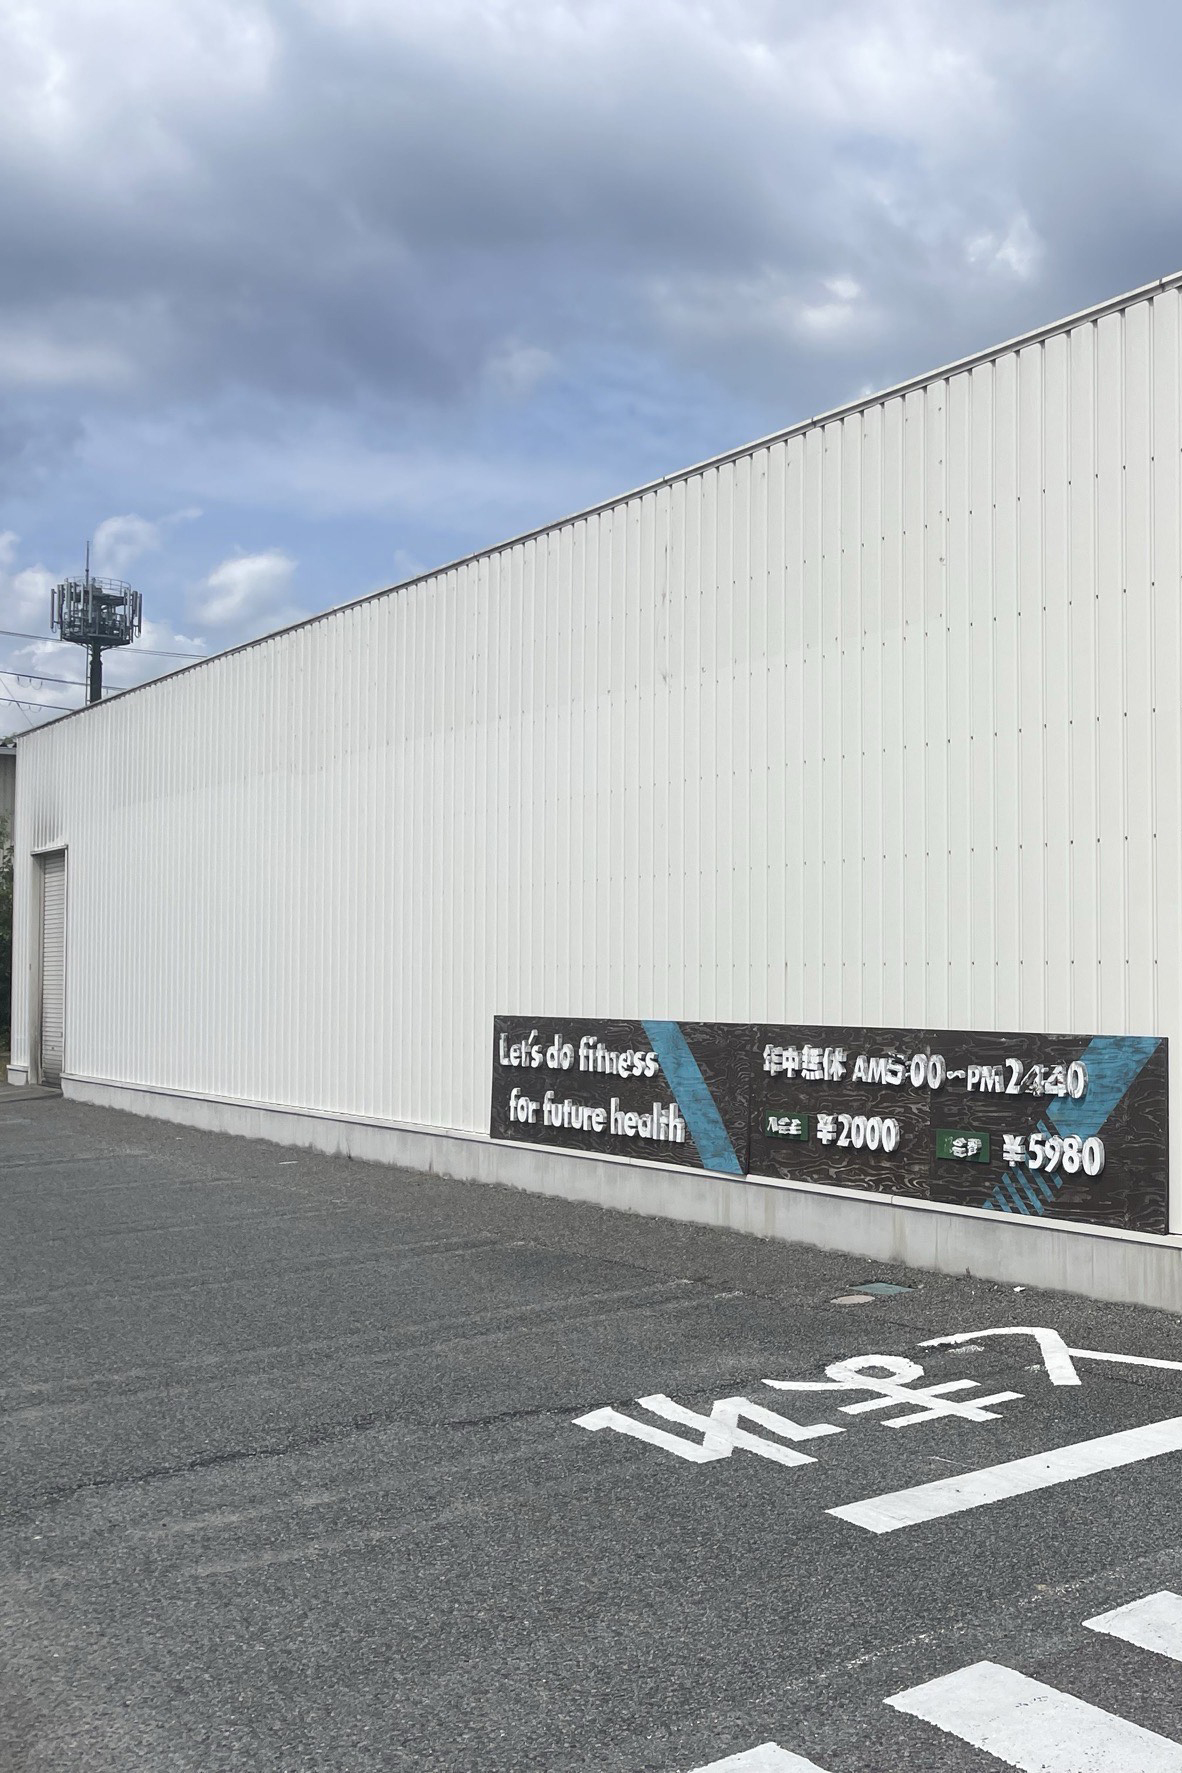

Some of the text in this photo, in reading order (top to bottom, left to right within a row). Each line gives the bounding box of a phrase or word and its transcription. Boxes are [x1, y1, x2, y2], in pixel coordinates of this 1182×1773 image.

[500, 1029, 659, 1078] Let's do fitness
[763, 1044, 847, 1082] 年中無休
[510, 1088, 686, 1143] for future health
[816, 1113, 900, 1153] ¥2000
[1002, 1132, 1106, 1176] ¥5980
